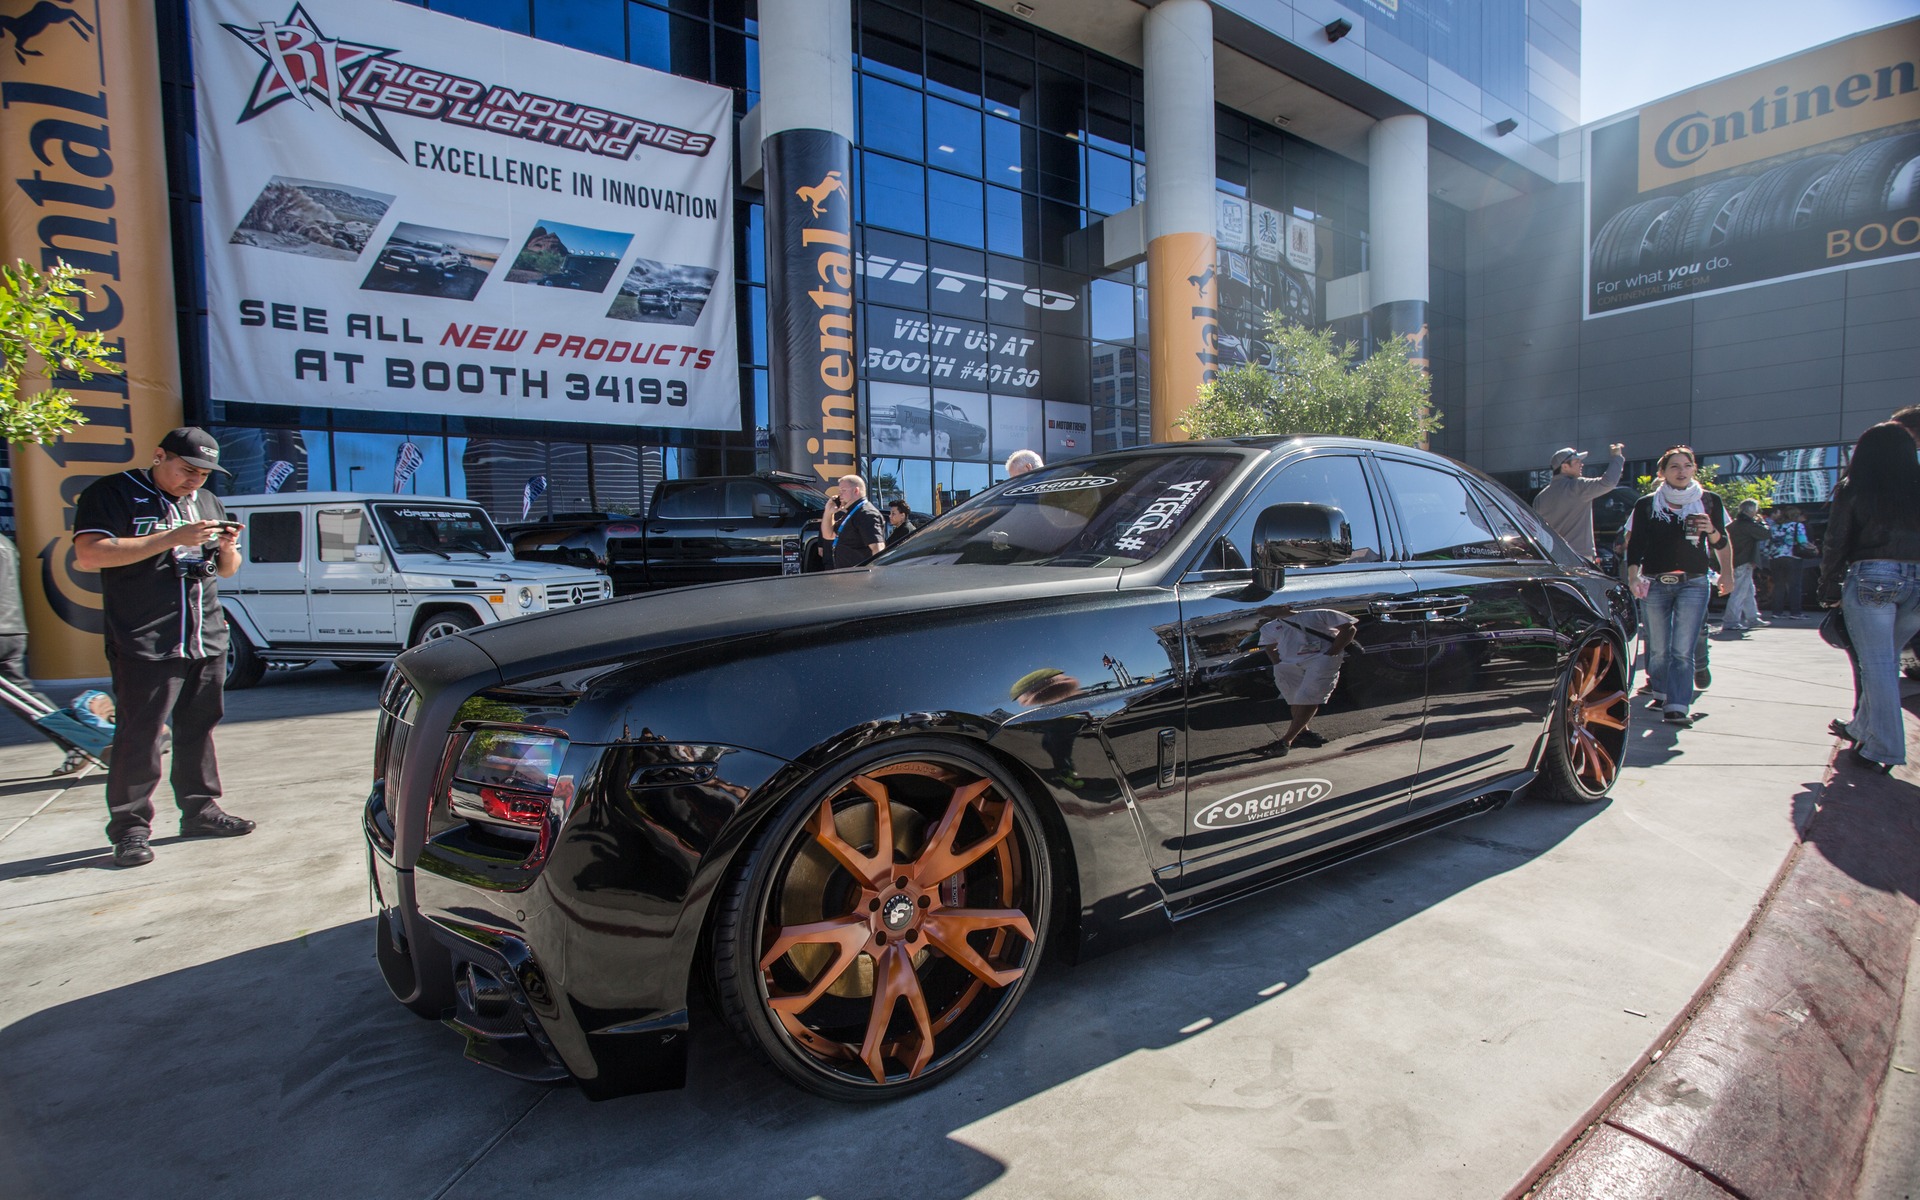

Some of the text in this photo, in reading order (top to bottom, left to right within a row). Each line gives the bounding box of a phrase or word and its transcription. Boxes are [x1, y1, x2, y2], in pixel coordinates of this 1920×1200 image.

[346, 78, 630, 157] LED LIGHTING
[368, 59, 713, 153] RIGID INDUSTRIES
[1654, 60, 1919, 169] Continen
[414, 140, 717, 219] EXCELLENCE IN INNOVATION
[1826, 216, 1920, 259] BOO
[1596, 256, 1732, 294] For what you do.
[239, 299, 716, 370] SEE ALL NEW PRODUCTS
[894, 318, 1034, 357] VISIT US AT
[295, 348, 688, 407] AT BOOTH 34193
[861, 347, 1040, 388] BOOTH #40130
[1009, 478, 1107, 494] FORGIATO
[394, 509, 472, 518] VÖRSTEINER
[1206, 784, 1323, 824] FORGIATO
[1247, 807, 1287, 821] WHEELS
